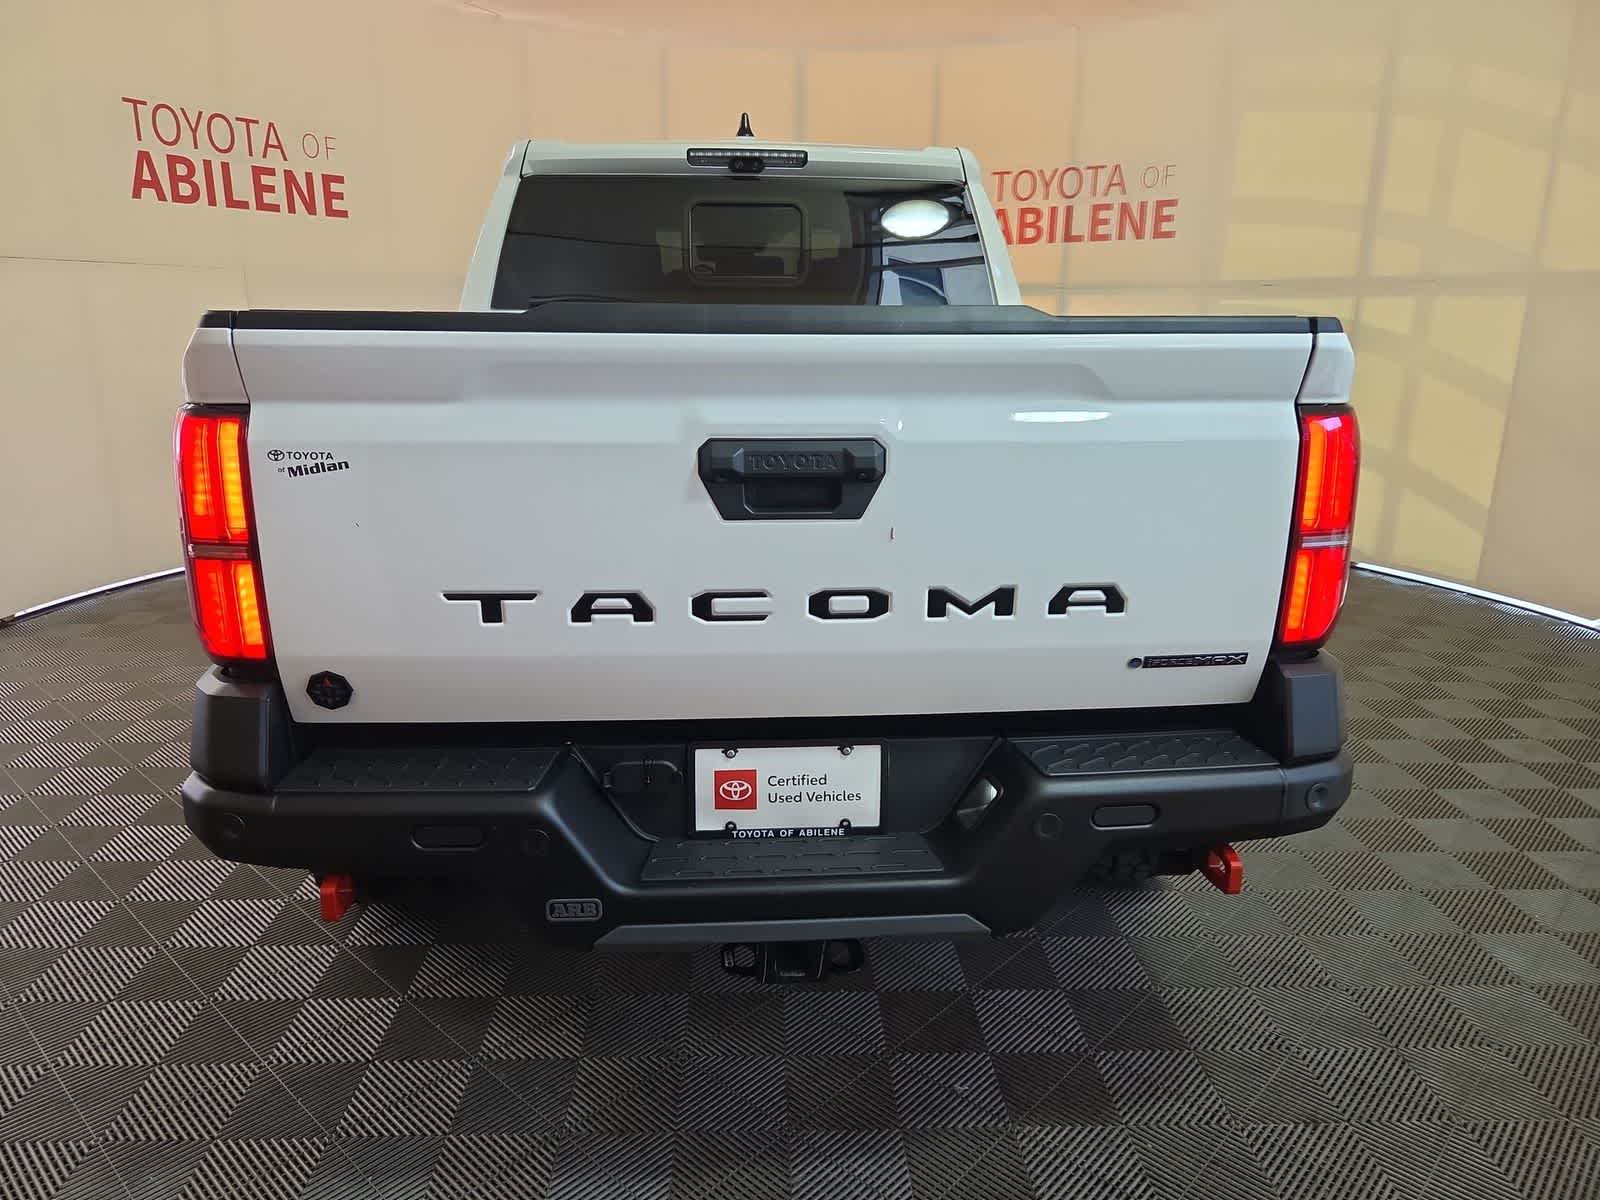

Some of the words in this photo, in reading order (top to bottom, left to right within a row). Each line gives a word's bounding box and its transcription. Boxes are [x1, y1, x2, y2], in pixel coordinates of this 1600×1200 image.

[121, 96, 288, 162] TOYOTA
[302, 133, 337, 160] OF
[131, 149, 349, 218] ABILENE
[992, 163, 1127, 202] TOYOTA
[1141, 164, 1177, 190] OF
[286, 451, 334, 460] TOYOTA
[748, 454, 839, 472] TOYOTA
[287, 461, 350, 478] Midlan
[441, 586, 1129, 624] TACOMA
[767, 774, 828, 787] Certified
[768, 792, 802, 803] Used
[806, 790, 862, 803] Vehicles
[732, 829, 775, 839] TOYOTA
[780, 829, 794, 837] OF
[799, 828, 845, 837] ABILENE
[551, 903, 597, 917] ARB
